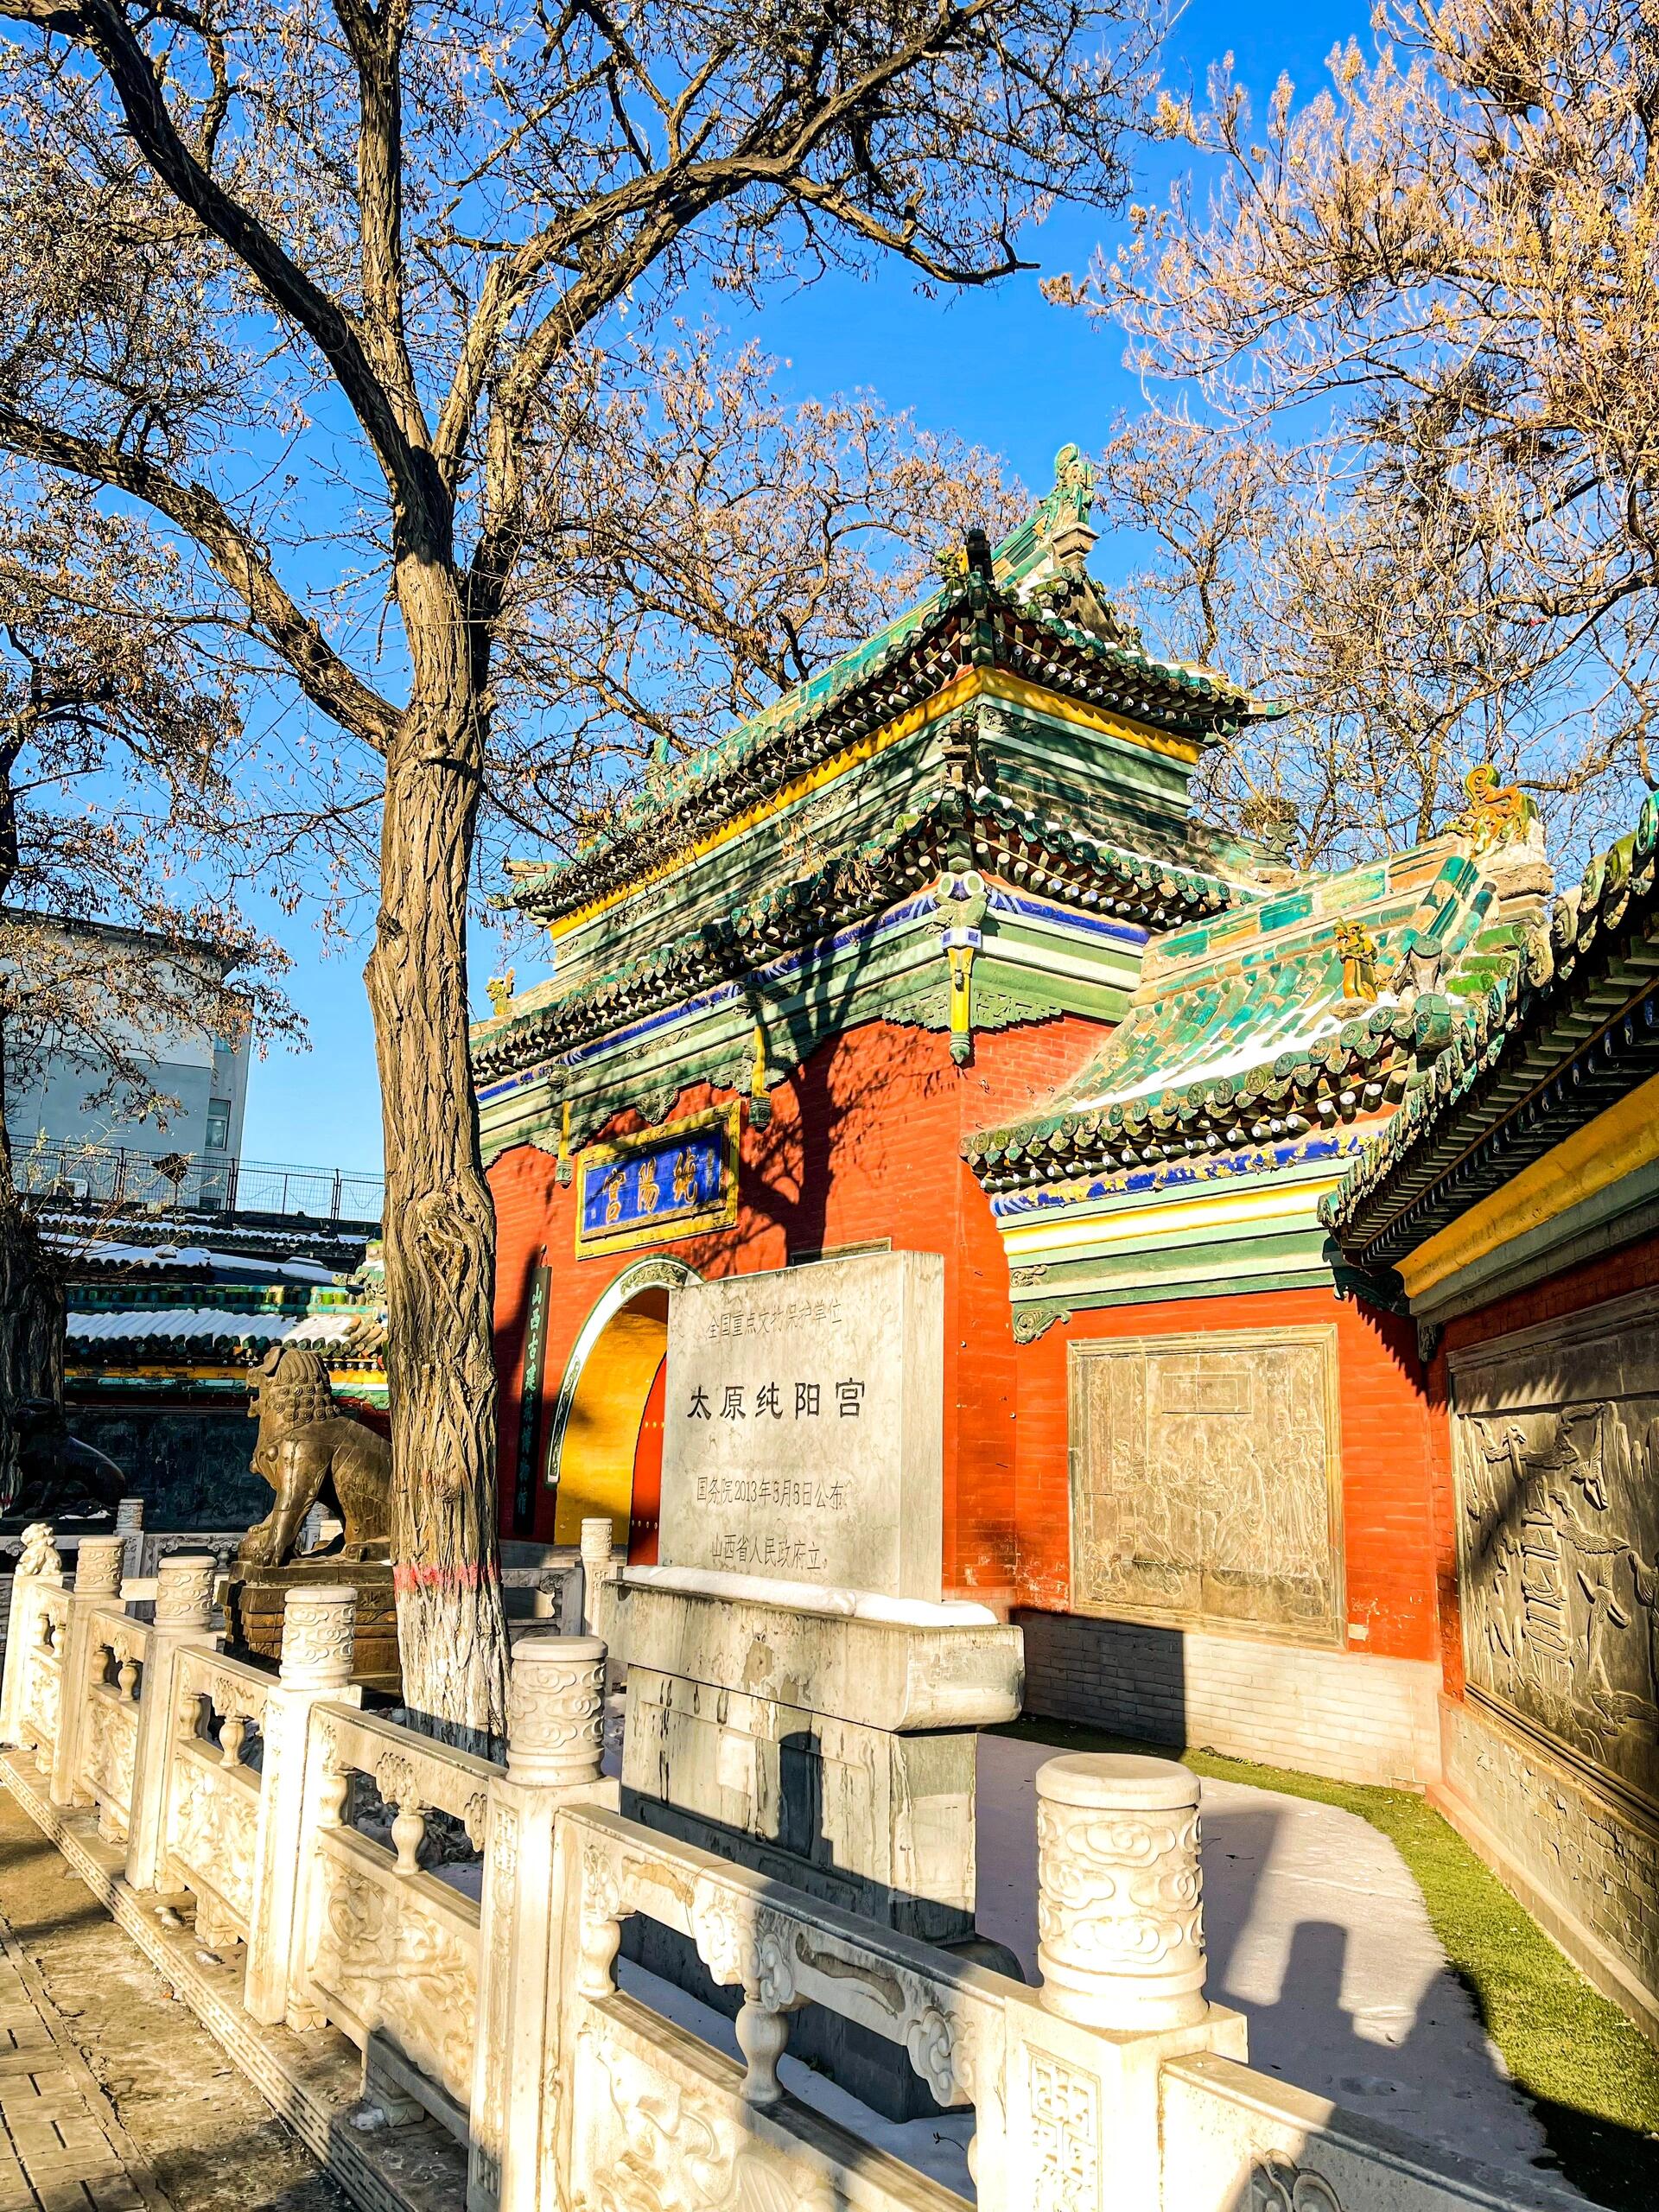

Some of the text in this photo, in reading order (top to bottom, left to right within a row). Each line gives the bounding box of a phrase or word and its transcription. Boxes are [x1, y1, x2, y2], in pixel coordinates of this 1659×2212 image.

[705, 1299, 842, 1339] 全国重点文物保护单位
[686, 1377, 865, 1421] 太原纯阳宫
